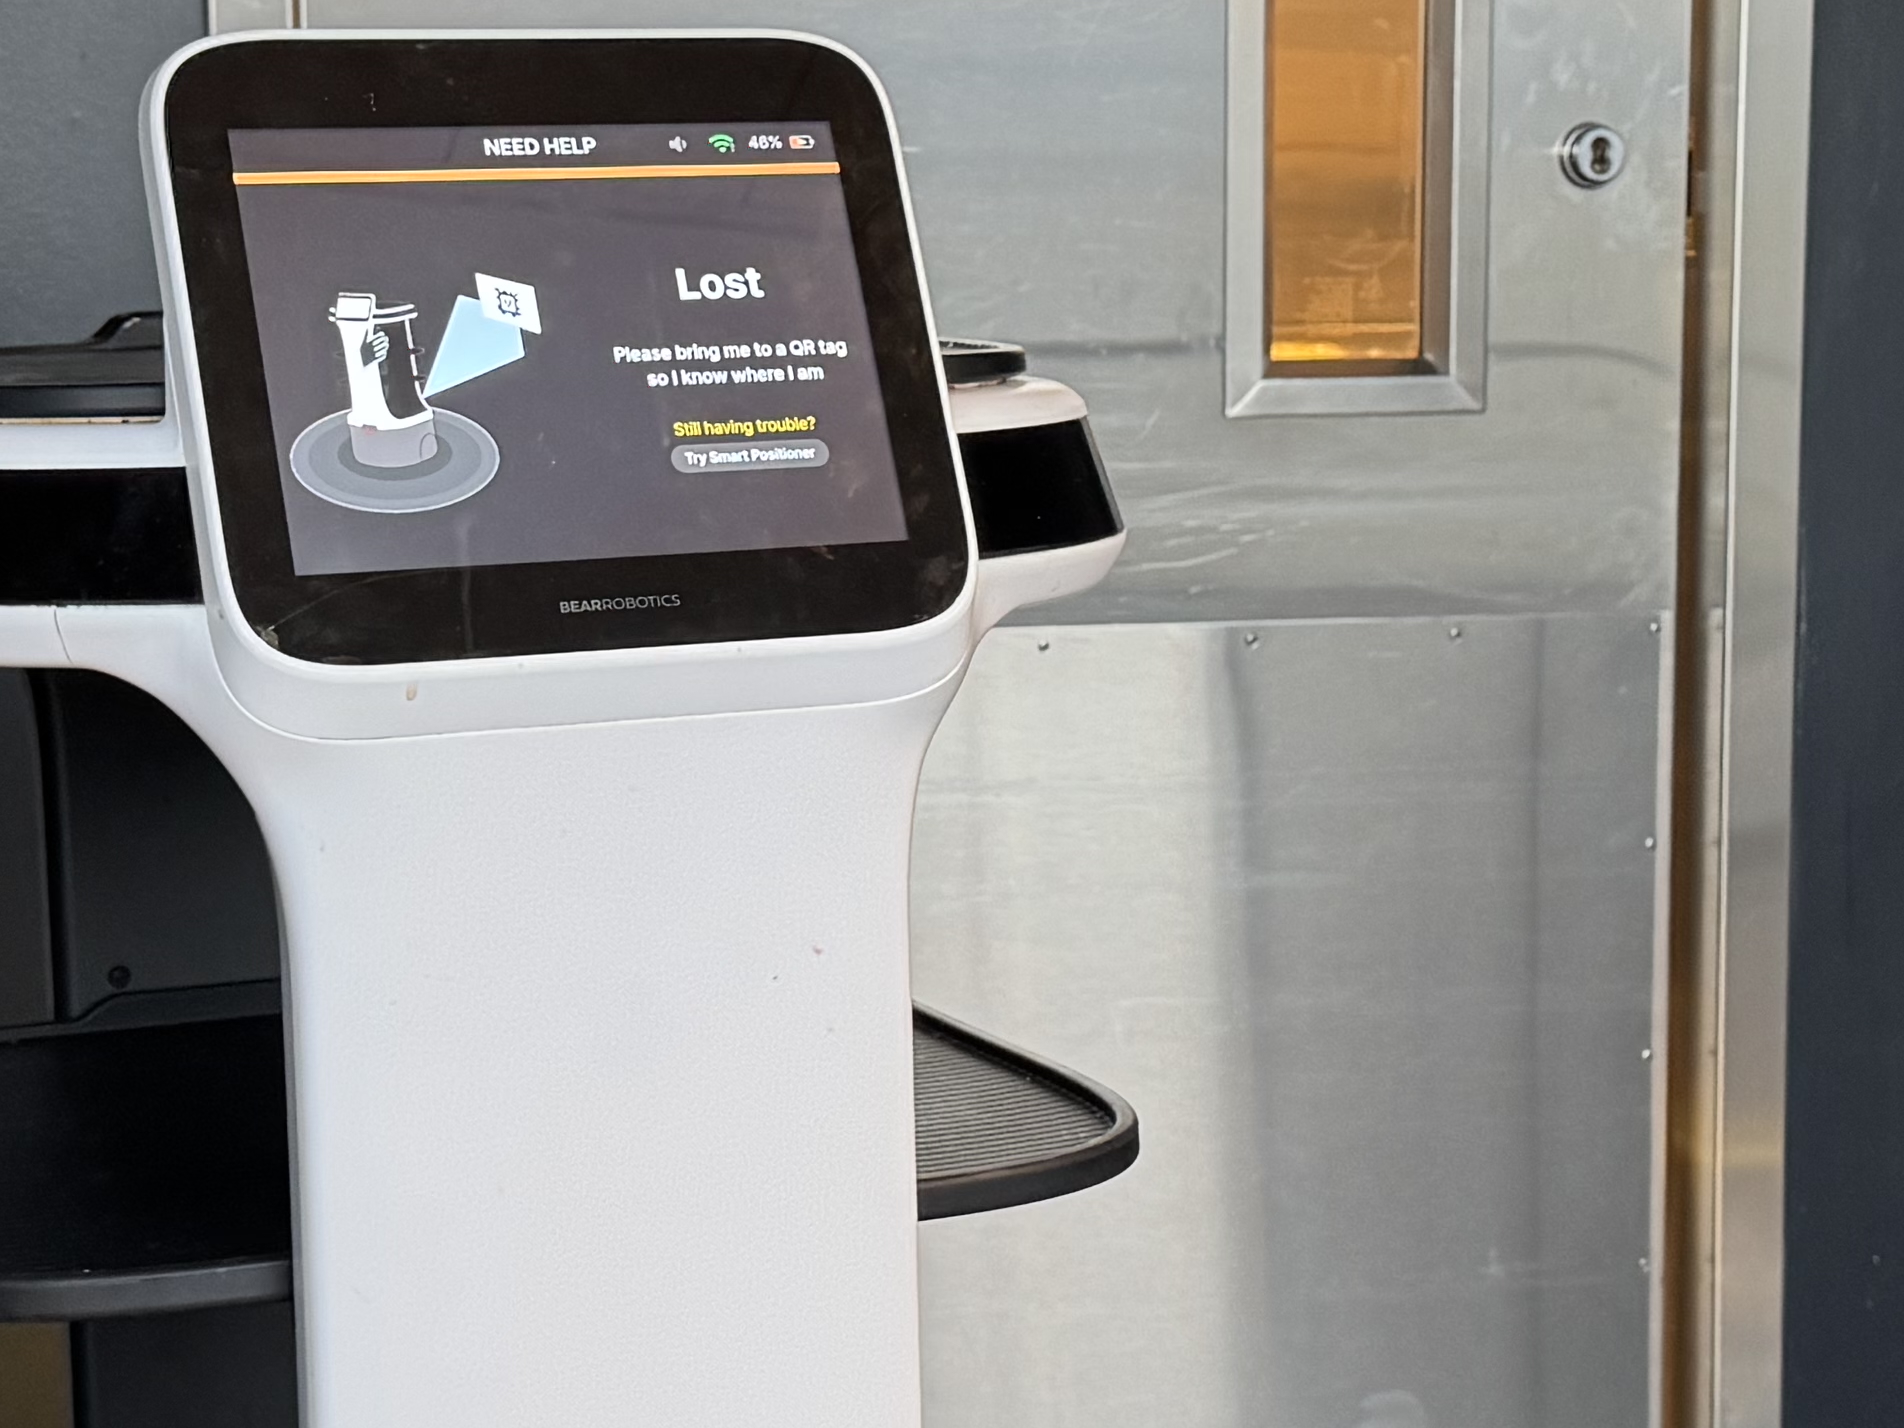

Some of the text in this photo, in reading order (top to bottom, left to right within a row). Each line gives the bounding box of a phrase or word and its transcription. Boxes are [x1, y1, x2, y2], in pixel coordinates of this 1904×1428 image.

[483, 136, 597, 156] NEED HELP
[674, 267, 766, 301] Lost
[613, 339, 848, 363] Please bring me to a QR tag
[647, 365, 825, 387] so I know where I am
[673, 416, 816, 437] Still having trouble?
[684, 447, 816, 467] Try Smart Positioner
[559, 594, 681, 613] BEARROBOTICS
